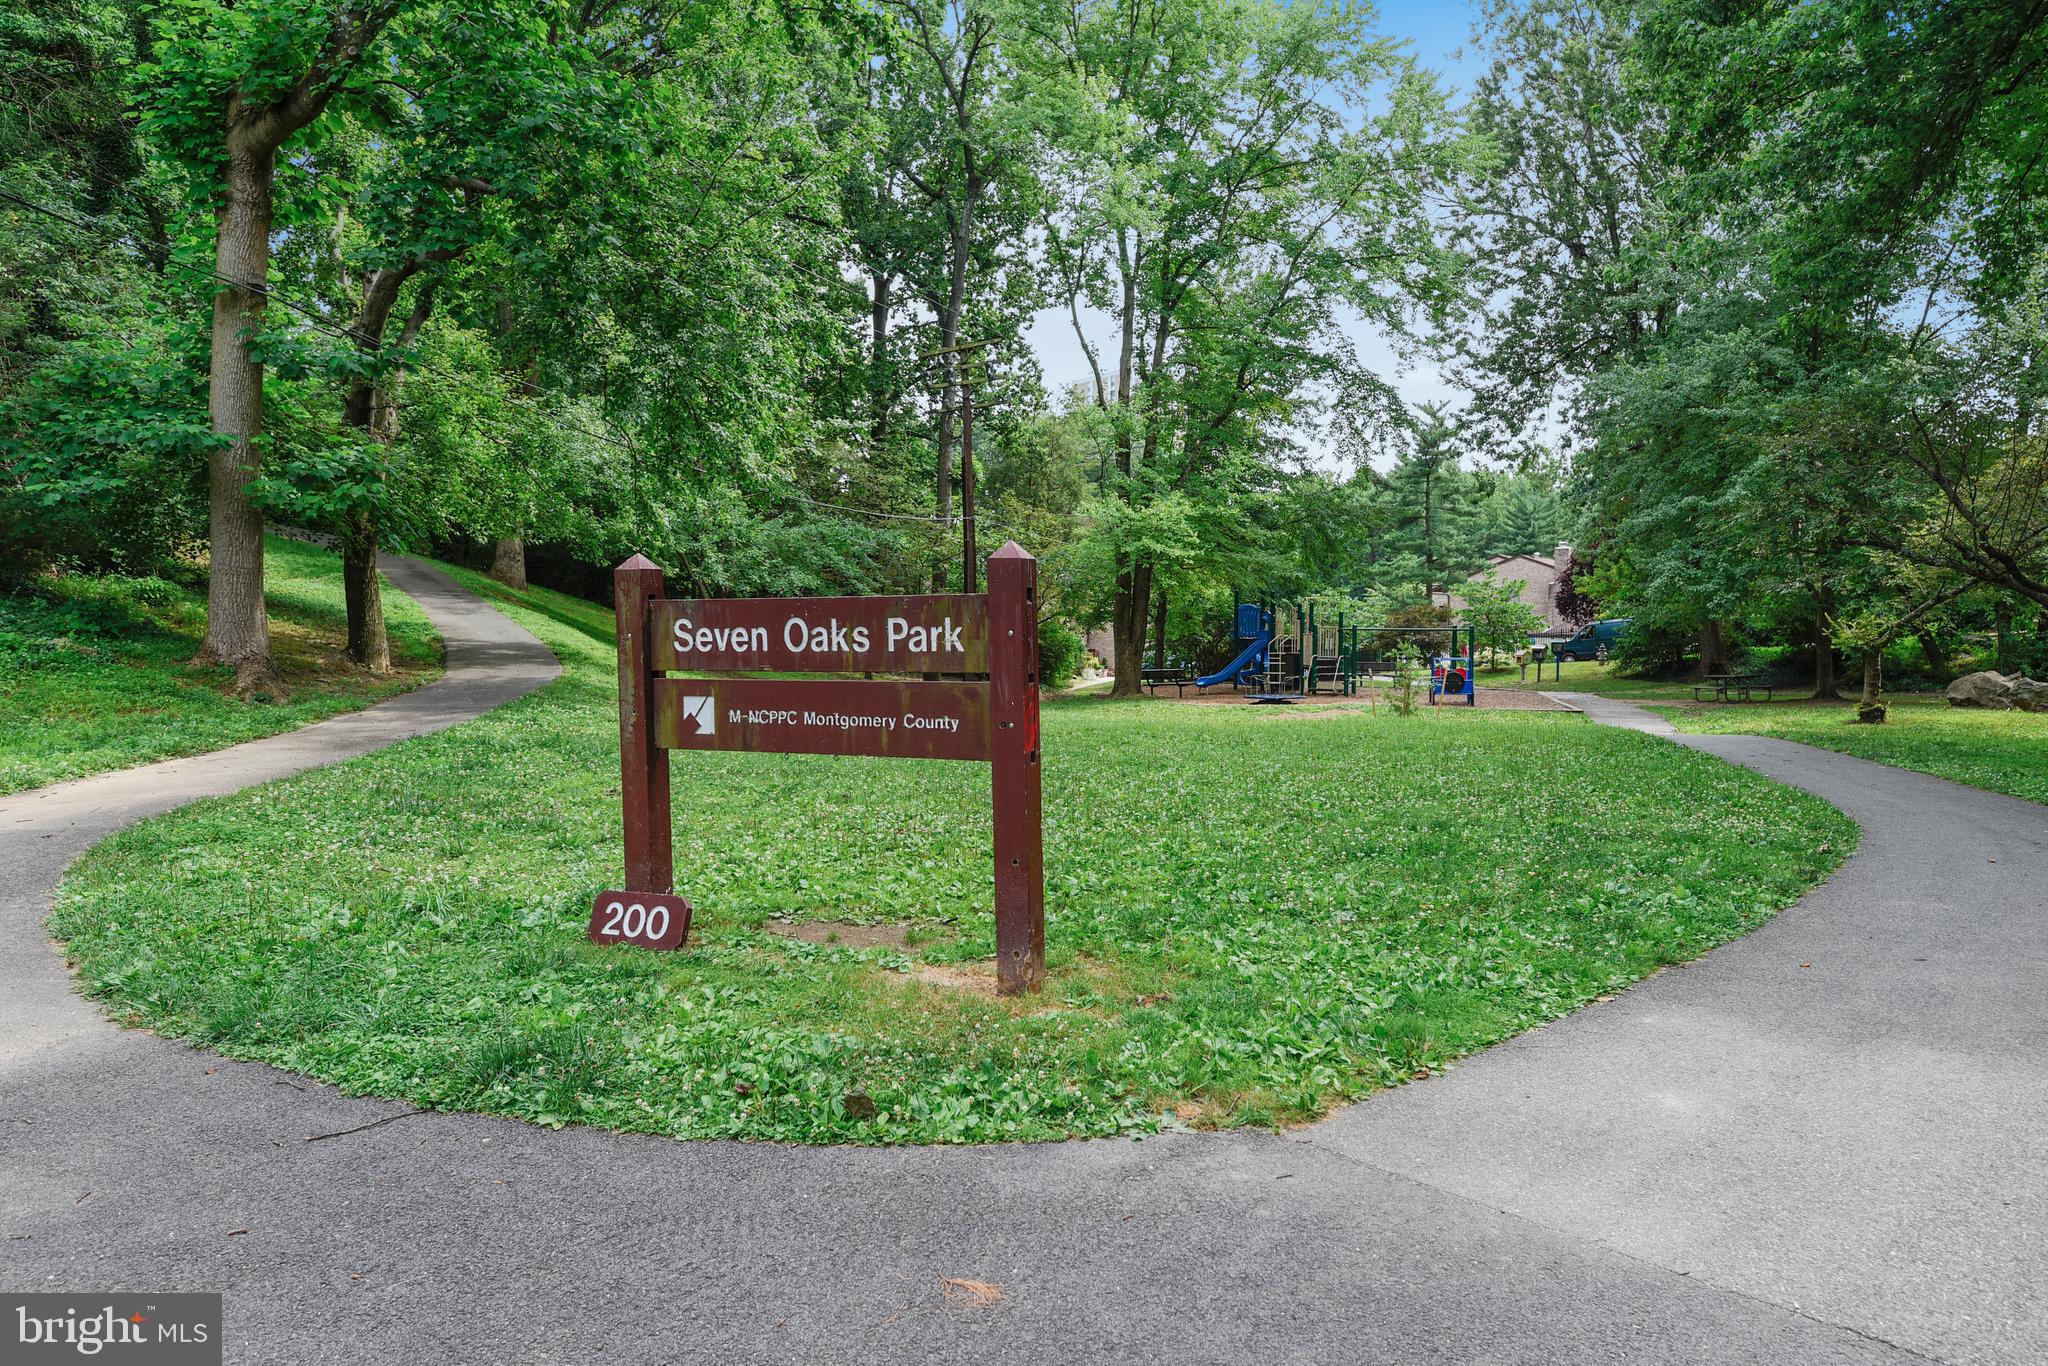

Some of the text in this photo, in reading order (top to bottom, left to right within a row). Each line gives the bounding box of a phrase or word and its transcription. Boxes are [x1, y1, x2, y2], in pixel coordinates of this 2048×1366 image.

[673, 617, 965, 653] Seven Oaks Park
[728, 709, 960, 732] M-NCPPC Montgomery County
[601, 902, 670, 940] 200
